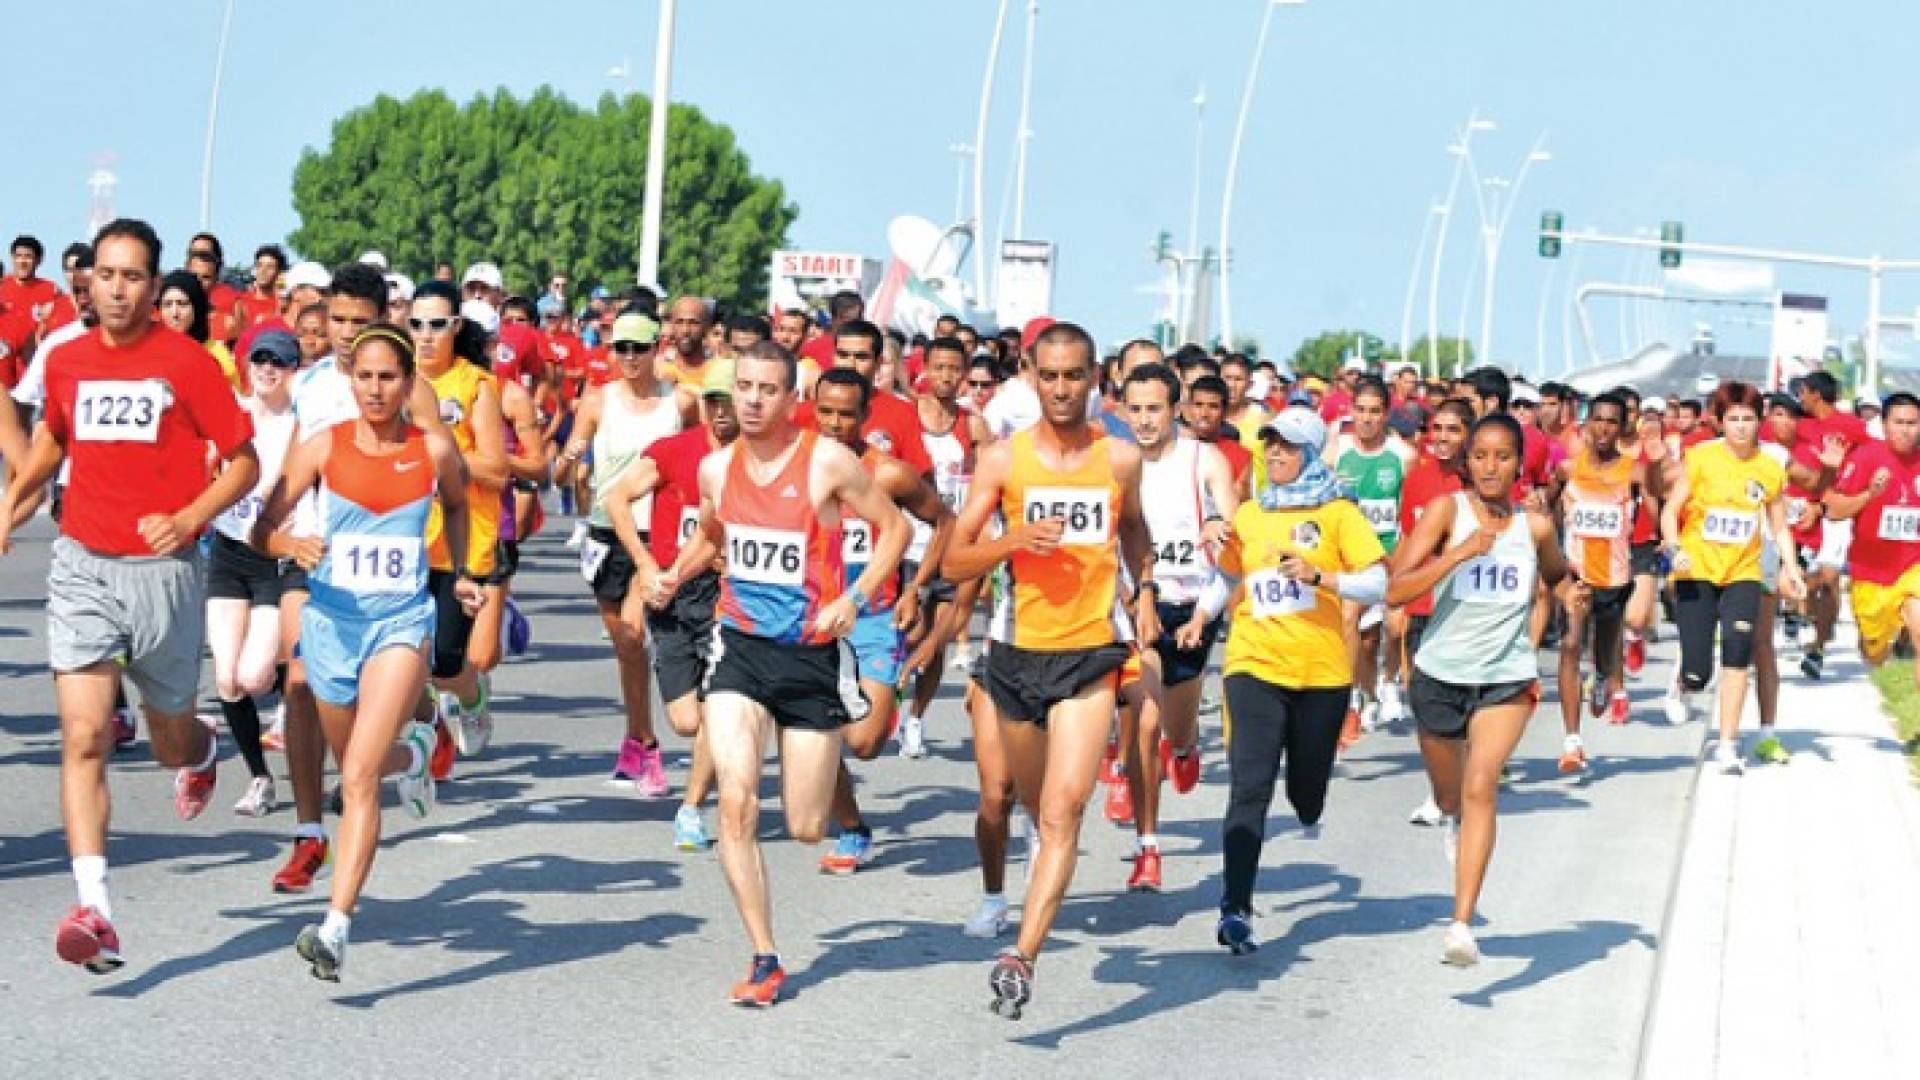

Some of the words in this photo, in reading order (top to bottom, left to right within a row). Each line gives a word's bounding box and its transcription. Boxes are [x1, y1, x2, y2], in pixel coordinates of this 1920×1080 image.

[783, 255, 856, 274] START
[82, 395, 153, 428] 1223
[1028, 501, 1103, 531] 0561
[1575, 510, 1618, 528] 0562
[1706, 514, 1751, 537] 0121
[347, 545, 403, 577] 118
[731, 537, 799, 573] 1076
[1469, 564, 1518, 591] 116
